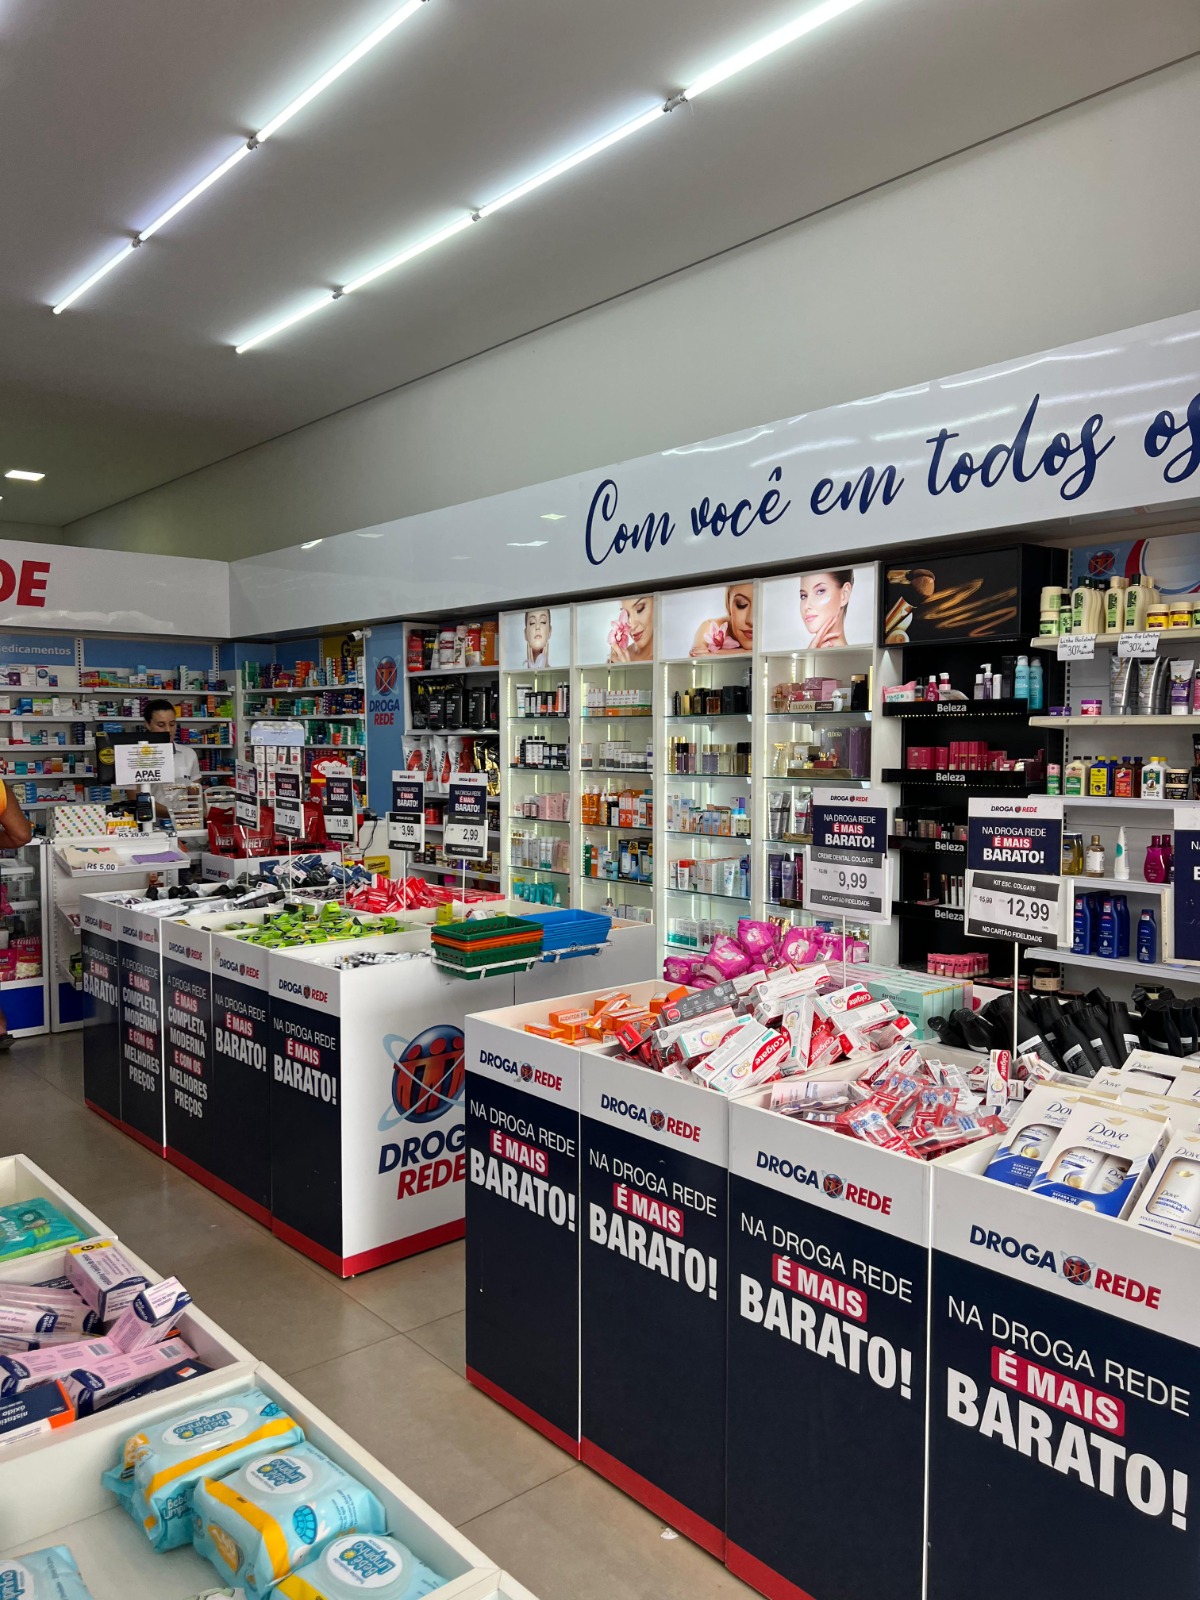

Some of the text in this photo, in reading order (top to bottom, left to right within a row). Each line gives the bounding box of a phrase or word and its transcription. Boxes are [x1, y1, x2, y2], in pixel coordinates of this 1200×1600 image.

[585, 392, 1200, 566] Com você em todos os
[0, 645, 71, 655] edicamentos
[1067, 645, 1081, 656] 30%
[1127, 643, 1142, 652] 30%
[369, 699, 400, 712] DROGA
[937, 703, 967, 712] Beleza
[374, 713, 394, 725] REDE
[135, 770, 161, 778] APAE
[936, 772, 965, 782] Beleza
[397, 799, 418, 807] BARATO!
[455, 804, 480, 812] BARATO!
[285, 814, 295, 825] 7,99
[336, 819, 348, 828] 11,99
[824, 814, 876, 824] NA DROGA REDE
[834, 823, 863, 833] É MAIS
[402, 825, 414, 837] 3,99
[463, 829, 478, 842] 2,99
[825, 833, 875, 848] BARATO!
[982, 827, 1046, 837] NA DROGA REDE
[995, 836, 1030, 847] É MAIS
[242, 839, 262, 848] WHEY
[935, 842, 964, 852] Beleza
[87, 863, 98, 871] R$
[852, 856, 873, 864] COLGATE
[983, 848, 1044, 864] BARATO!
[839, 871, 867, 890] 9,99
[1013, 883, 1036, 891] COLGATE
[934, 910, 964, 921] Beleza
[1007, 897, 1049, 921] 12,99
[84, 915, 112, 932] DROGA REDE
[123, 926, 154, 943] DROGA REDE
[991, 927, 1012, 937] CARTÃO
[1013, 930, 1042, 943] FIDELIDADE
[105, 952, 117, 967] REDE
[169, 942, 202, 961] DROGA REDE
[90, 962, 108, 978] É MAIS
[121, 957, 158, 980] A DROGA REDE
[219, 958, 259, 979] DROGA REDE
[83, 973, 118, 1007] BARATO!
[129, 972, 149, 991] É MAIS
[167, 976, 207, 1000] A DROGA REDE
[279, 979, 328, 1003] DROGA REDE
[123, 987, 159, 1019] COMPLETA,
[175, 992, 197, 1013] É MAIS
[215, 993, 266, 1023] NA DROGA REDE
[848, 993, 872, 1008] Colgate
[124, 1007, 157, 1035] MODERNA
[168, 1006, 207, 1041] COMPLETA,
[227, 1013, 252, 1037] É MAIS
[129, 1030, 154, 1050] E COM OS
[170, 1027, 205, 1058] MODERNA
[273, 1018, 336, 1051] NA DROGA REDE
[124, 1044, 160, 1075] MELHORES
[215, 1027, 266, 1072] BARATO!
[287, 1038, 319, 1065] É MAIS
[755, 1038, 785, 1067] Colgate
[810, 1036, 835, 1062] Colgate
[175, 1050, 201, 1075] E COM OS
[479, 1050, 563, 1091] DROGA REDE
[999, 1051, 1010, 1076] Colgate
[130, 1066, 155, 1092] PREÇOS
[170, 1066, 207, 1100] MELHORES
[273, 1054, 337, 1106] BARATO!
[175, 1089, 203, 1118] PREÇOS
[470, 1099, 575, 1158] NA DROGA REDE
[601, 1094, 701, 1143] DROGA REDE
[1089, 1122, 1129, 1141] Dove
[378, 1123, 465, 1174] DROG
[493, 1130, 546, 1173] É MAIS
[397, 1153, 466, 1200] REDE
[589, 1148, 717, 1218] NA DROGA REDE
[757, 1151, 892, 1215] DROGA REDE
[470, 1147, 576, 1233] BARATO!
[617, 1184, 681, 1233] É MAIS
[589, 1201, 718, 1301] BARATO!
[741, 1212, 913, 1303] NA DROGA REDE
[969, 1224, 1162, 1310] DROGA REDE
[777, 1256, 863, 1317] É MAIS
[740, 1273, 912, 1401] BARATO!
[948, 1295, 1190, 1417] NA DROGA REDE
[999, 1349, 1119, 1430] É MAIS
[173, 1411, 232, 1434] Limpinho
[195, 1419, 229, 1435] Bebê
[947, 1367, 1188, 1531] BARATO!
[348, 1556, 378, 1578] Bebê
[353, 1542, 396, 1575] Limpinho
